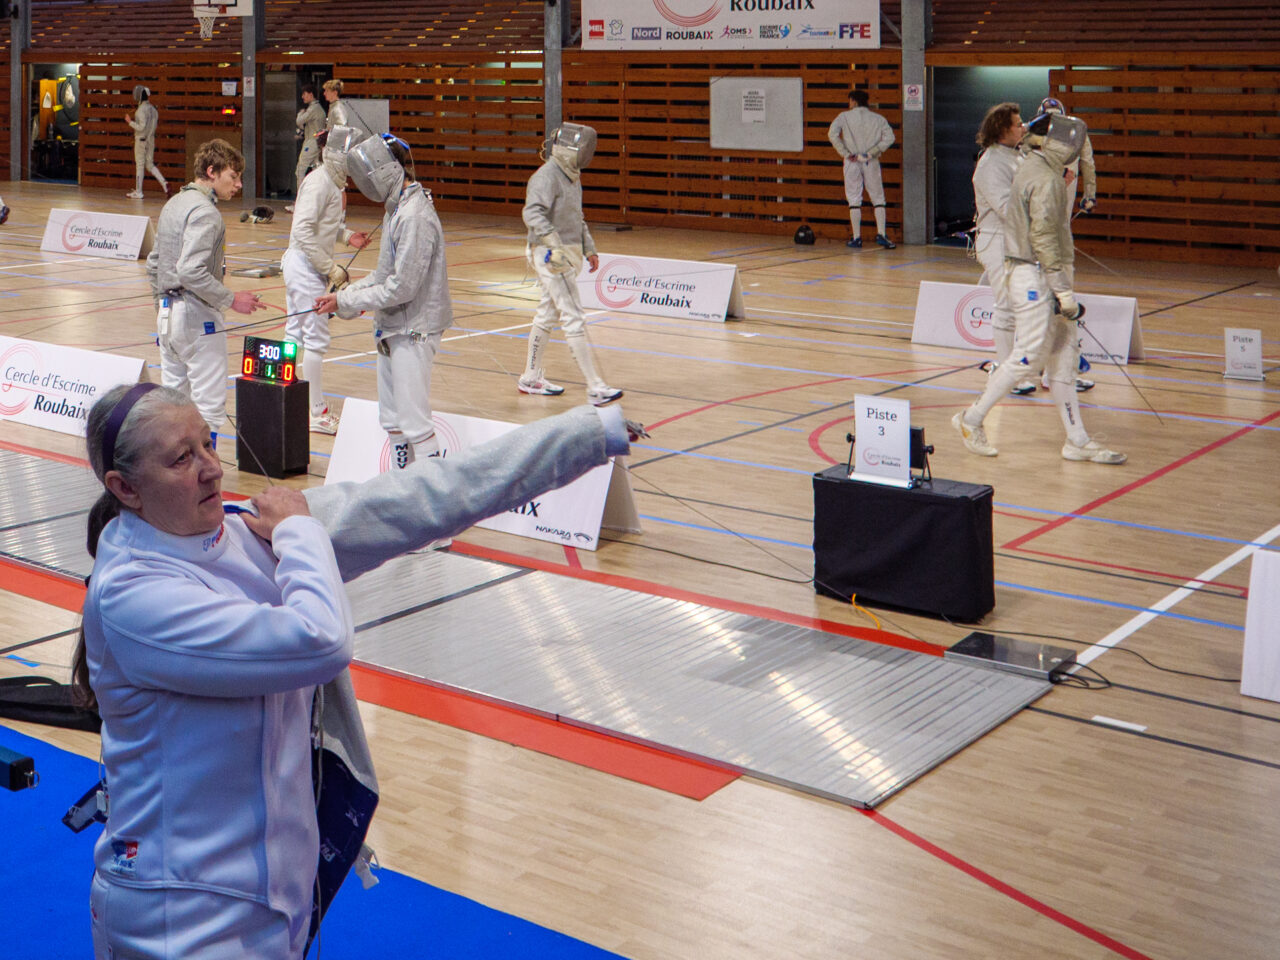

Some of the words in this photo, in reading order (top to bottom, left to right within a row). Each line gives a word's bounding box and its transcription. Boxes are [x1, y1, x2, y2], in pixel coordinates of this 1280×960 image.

[633, 28, 660, 38] Nord
[666, 30, 713, 40] ROUBAIX
[838, 23, 871, 39] FFE
[70, 225, 91, 234] Cercle
[91, 226, 123, 238] d'Escrime
[87, 238, 119, 250] Roubaix
[608, 274, 643, 288] Cercle
[644, 277, 696, 293] d'Escrime
[640, 292, 693, 309] Roubaix
[971, 306, 993, 320] Cer
[259, 344, 281, 360] 3:00
[244, 357, 253, 374] 0
[284, 364, 293, 380] 0
[5, 366, 40, 385] Cercle
[41, 373, 96, 397] d'Escrime
[33, 394, 90, 420] Roubaix
[866, 407, 897, 421] Piste
[878, 425, 885, 436] 3
[535, 525, 571, 538] NAKARA
